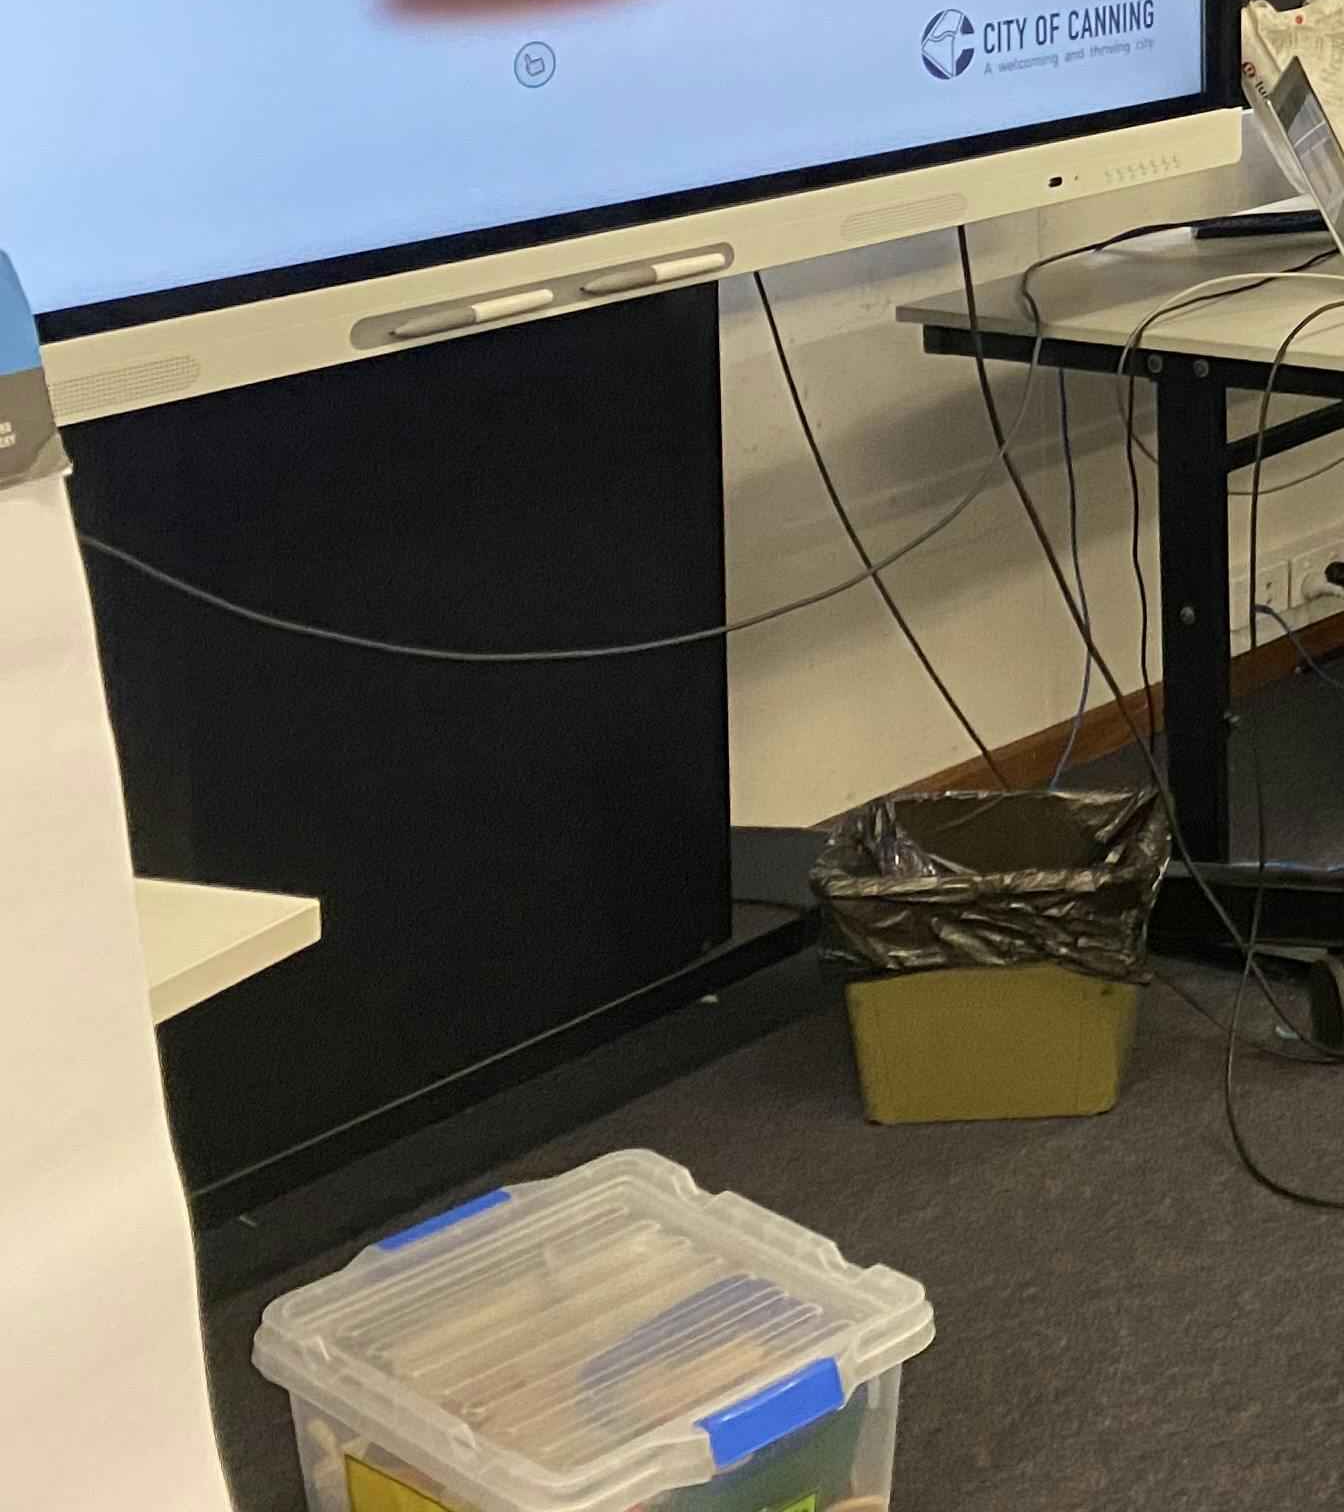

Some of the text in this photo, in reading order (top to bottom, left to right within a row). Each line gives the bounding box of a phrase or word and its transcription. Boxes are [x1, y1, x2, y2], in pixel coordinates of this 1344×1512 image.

[983, 17, 1027, 54] CITY
[1035, 12, 1061, 46] OF
[984, 62, 993, 75] A
[998, 53, 1059, 73] welcoming
[1064, 47, 1085, 62] and
[1090, 40, 1130, 58] thriving
